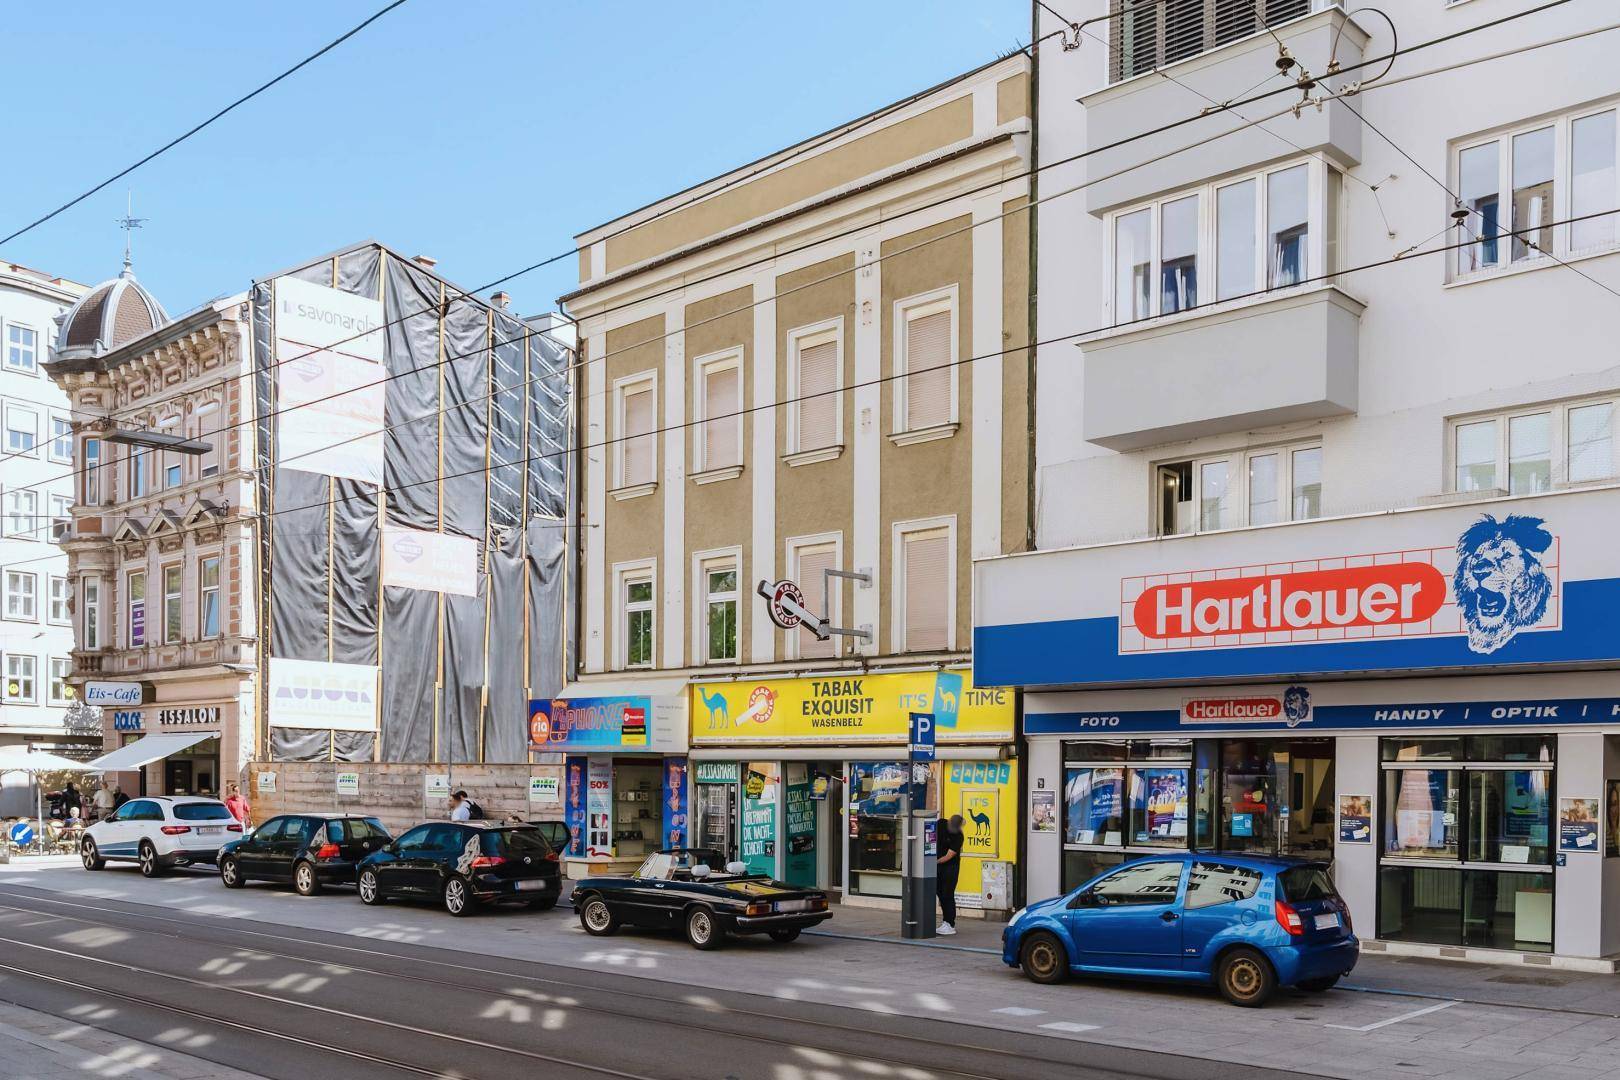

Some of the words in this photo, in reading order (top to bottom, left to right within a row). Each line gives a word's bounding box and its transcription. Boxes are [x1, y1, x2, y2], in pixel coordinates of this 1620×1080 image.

[779, 583, 804, 604] TABAK
[775, 600, 798, 625] TRAFIK
[1156, 578, 1422, 635] Hartlauer
[749, 688, 771, 706] TABAK
[812, 680, 863, 697] TABAK
[802, 698, 874, 716] EXQUISIT
[899, 694, 928, 709] IT'S
[965, 689, 1006, 706] TIME
[157, 707, 217, 725] EISSALON
[1193, 701, 1274, 718] Hartlauer
[1374, 708, 1444, 721] HANDY
[1491, 706, 1559, 719] OPTIK
[533, 717, 548, 732] ria
[812, 717, 863, 728] WASENBELZ
[917, 717, 931, 743] P
[1080, 716, 1120, 727] FOTO
[952, 766, 1008, 778] CAMEL
[590, 781, 609, 789] 50%
[969, 797, 990, 807] IT'S
[967, 836, 992, 847] TIME
